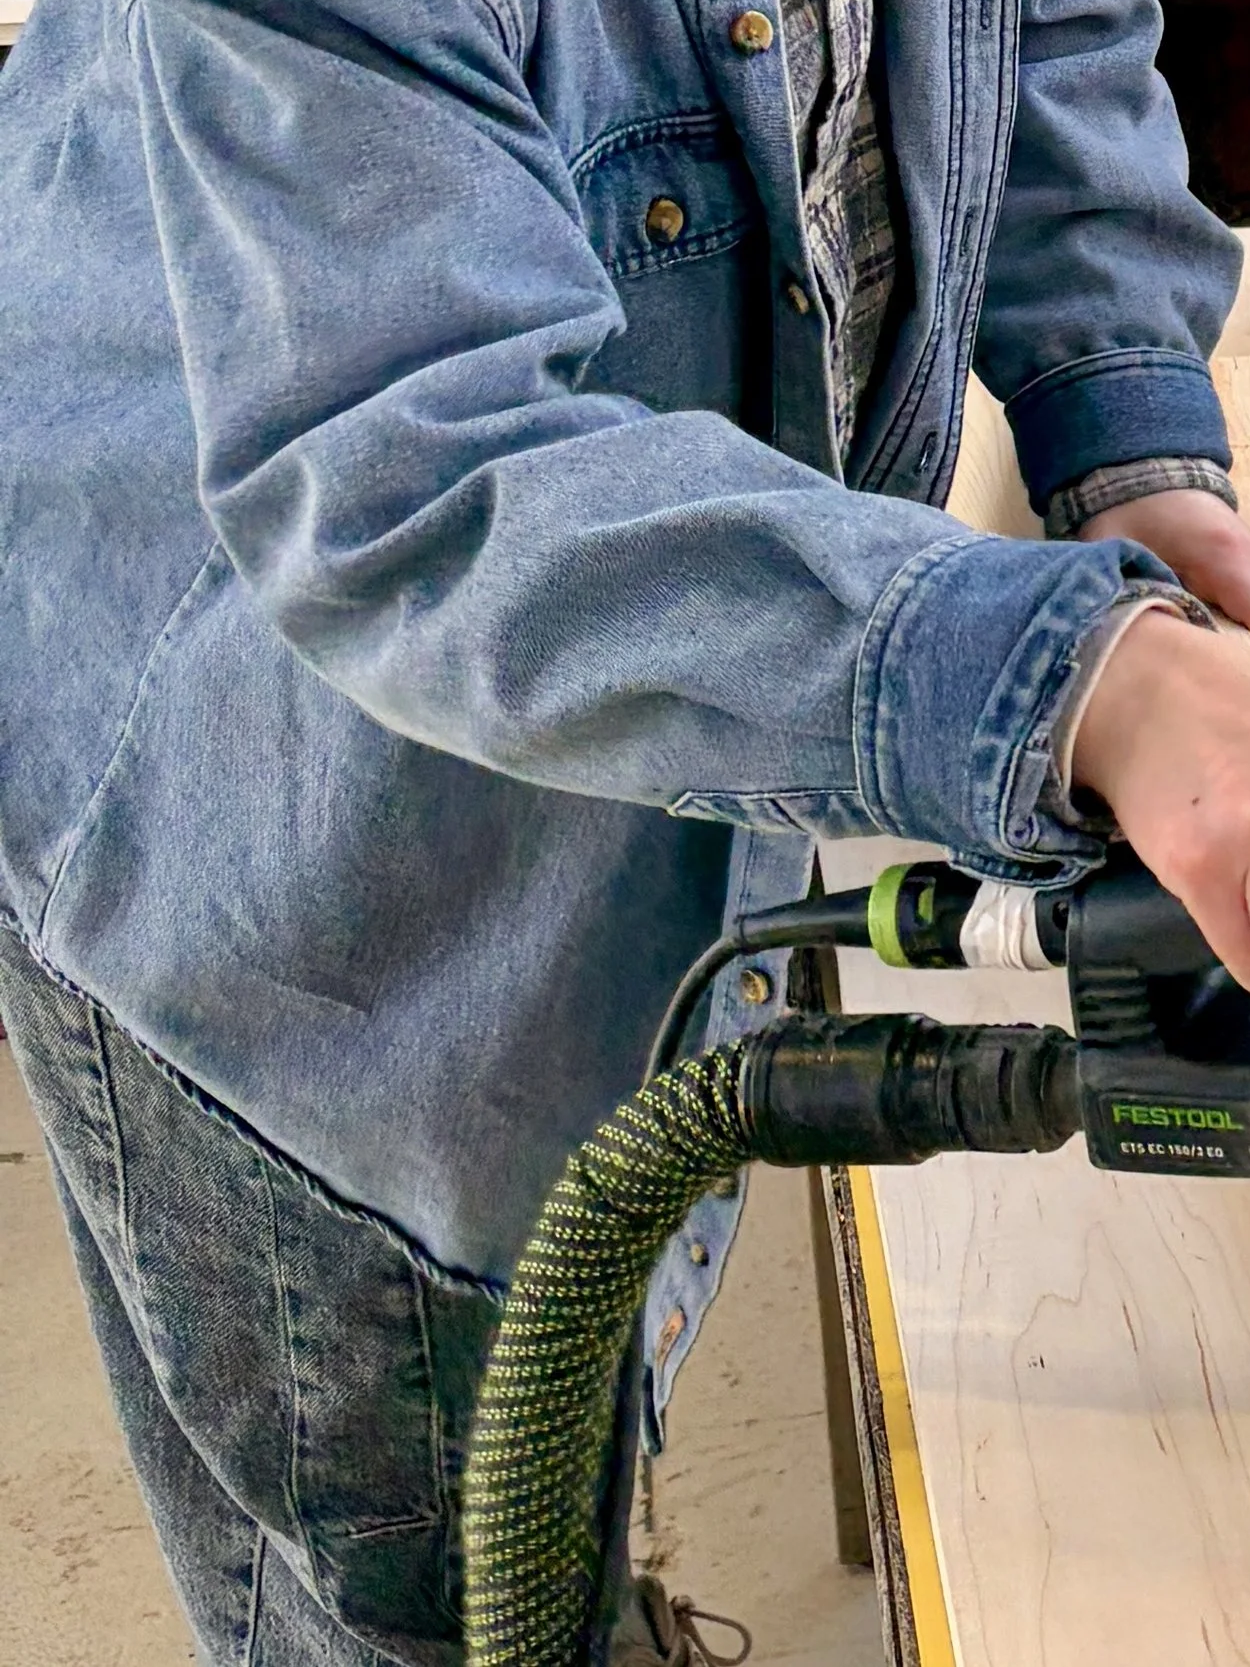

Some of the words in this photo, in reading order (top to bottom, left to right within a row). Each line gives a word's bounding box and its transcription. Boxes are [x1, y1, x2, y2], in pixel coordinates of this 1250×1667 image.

[1111, 1102, 1245, 1131] FESTOOL
[1120, 1141, 1145, 1155] ETS
[1147, 1142, 1165, 1155] EC
